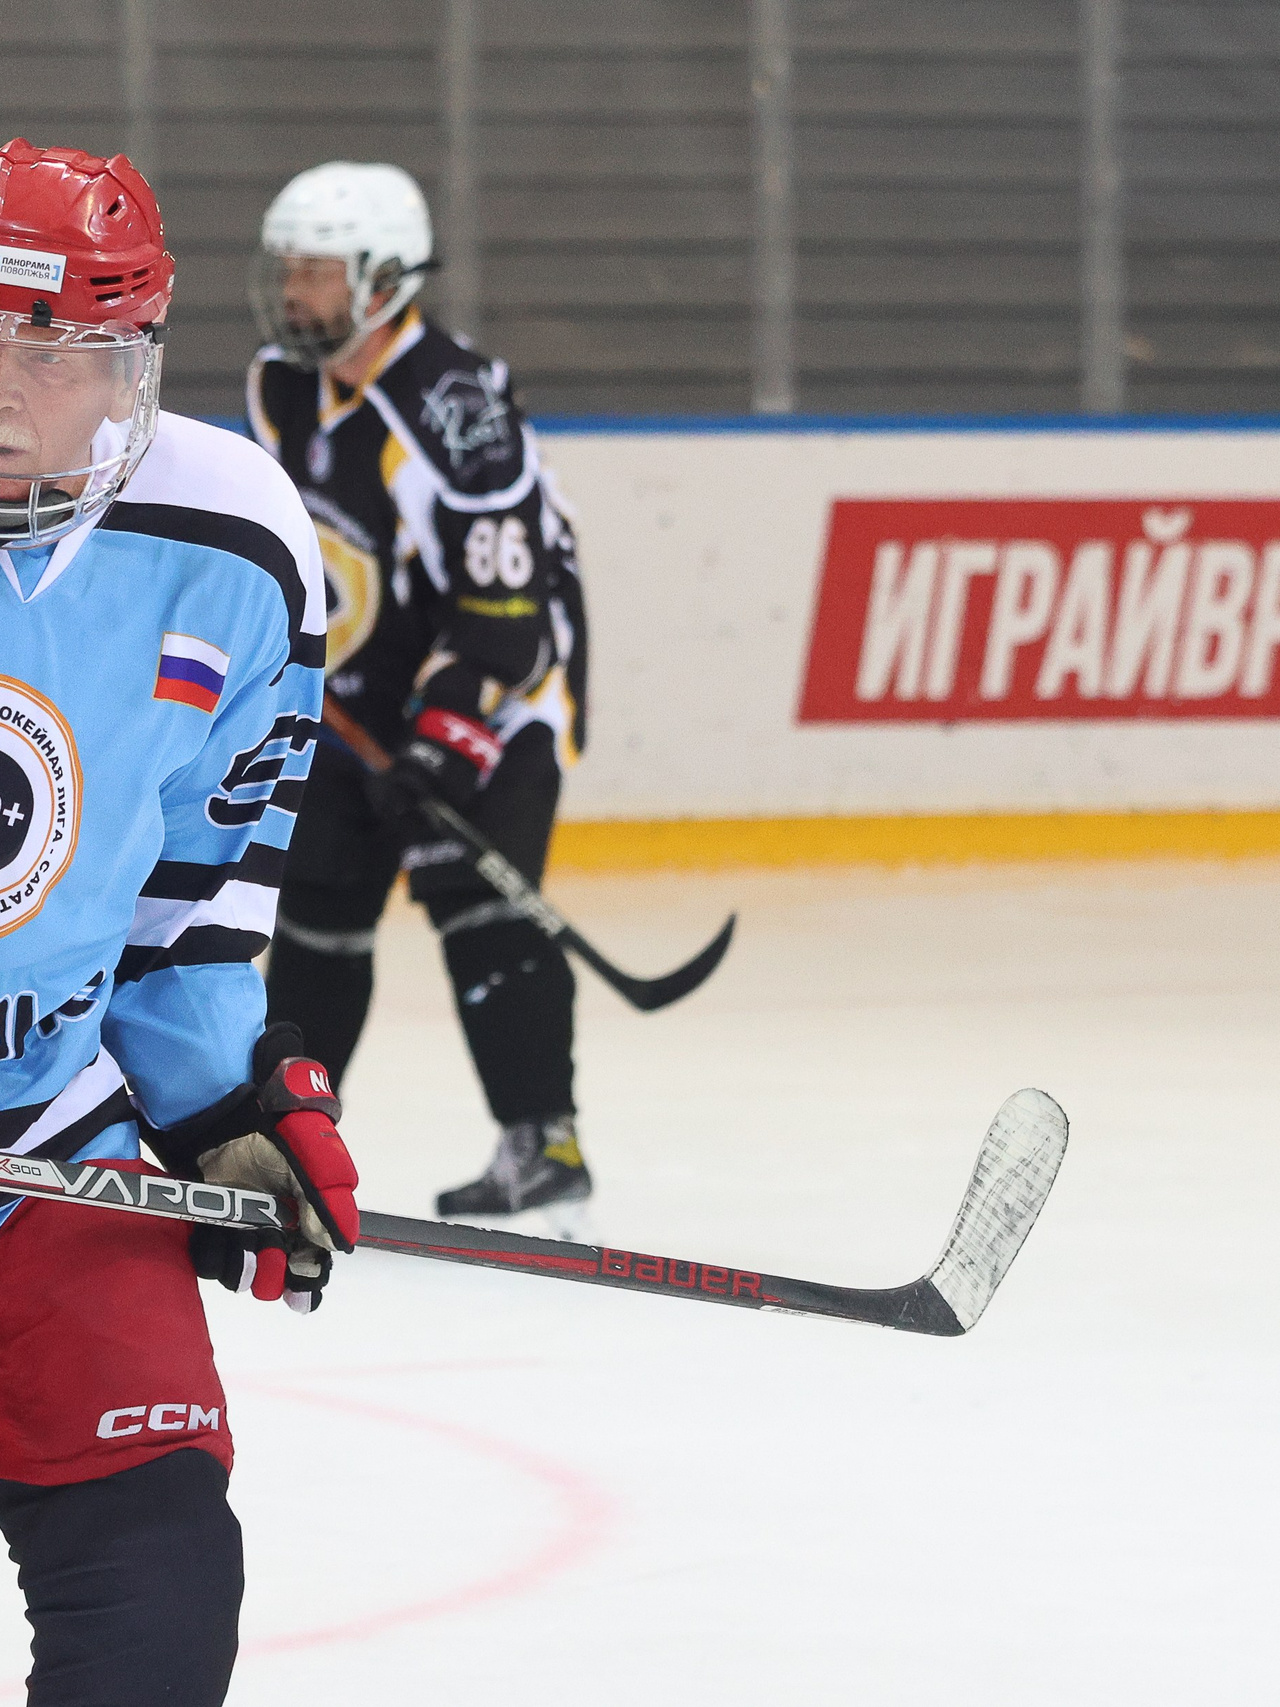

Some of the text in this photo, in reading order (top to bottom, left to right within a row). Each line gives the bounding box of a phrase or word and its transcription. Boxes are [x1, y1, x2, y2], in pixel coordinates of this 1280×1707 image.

[0, 265, 50, 280] ПОВОЛЖЬЯ
[1, 256, 51, 271] ПАНОРАМА
[51, 786, 67, 843] ЛИГА
[46, 1158, 283, 1229] VAPOR
[95, 1403, 220, 1440] CCM
